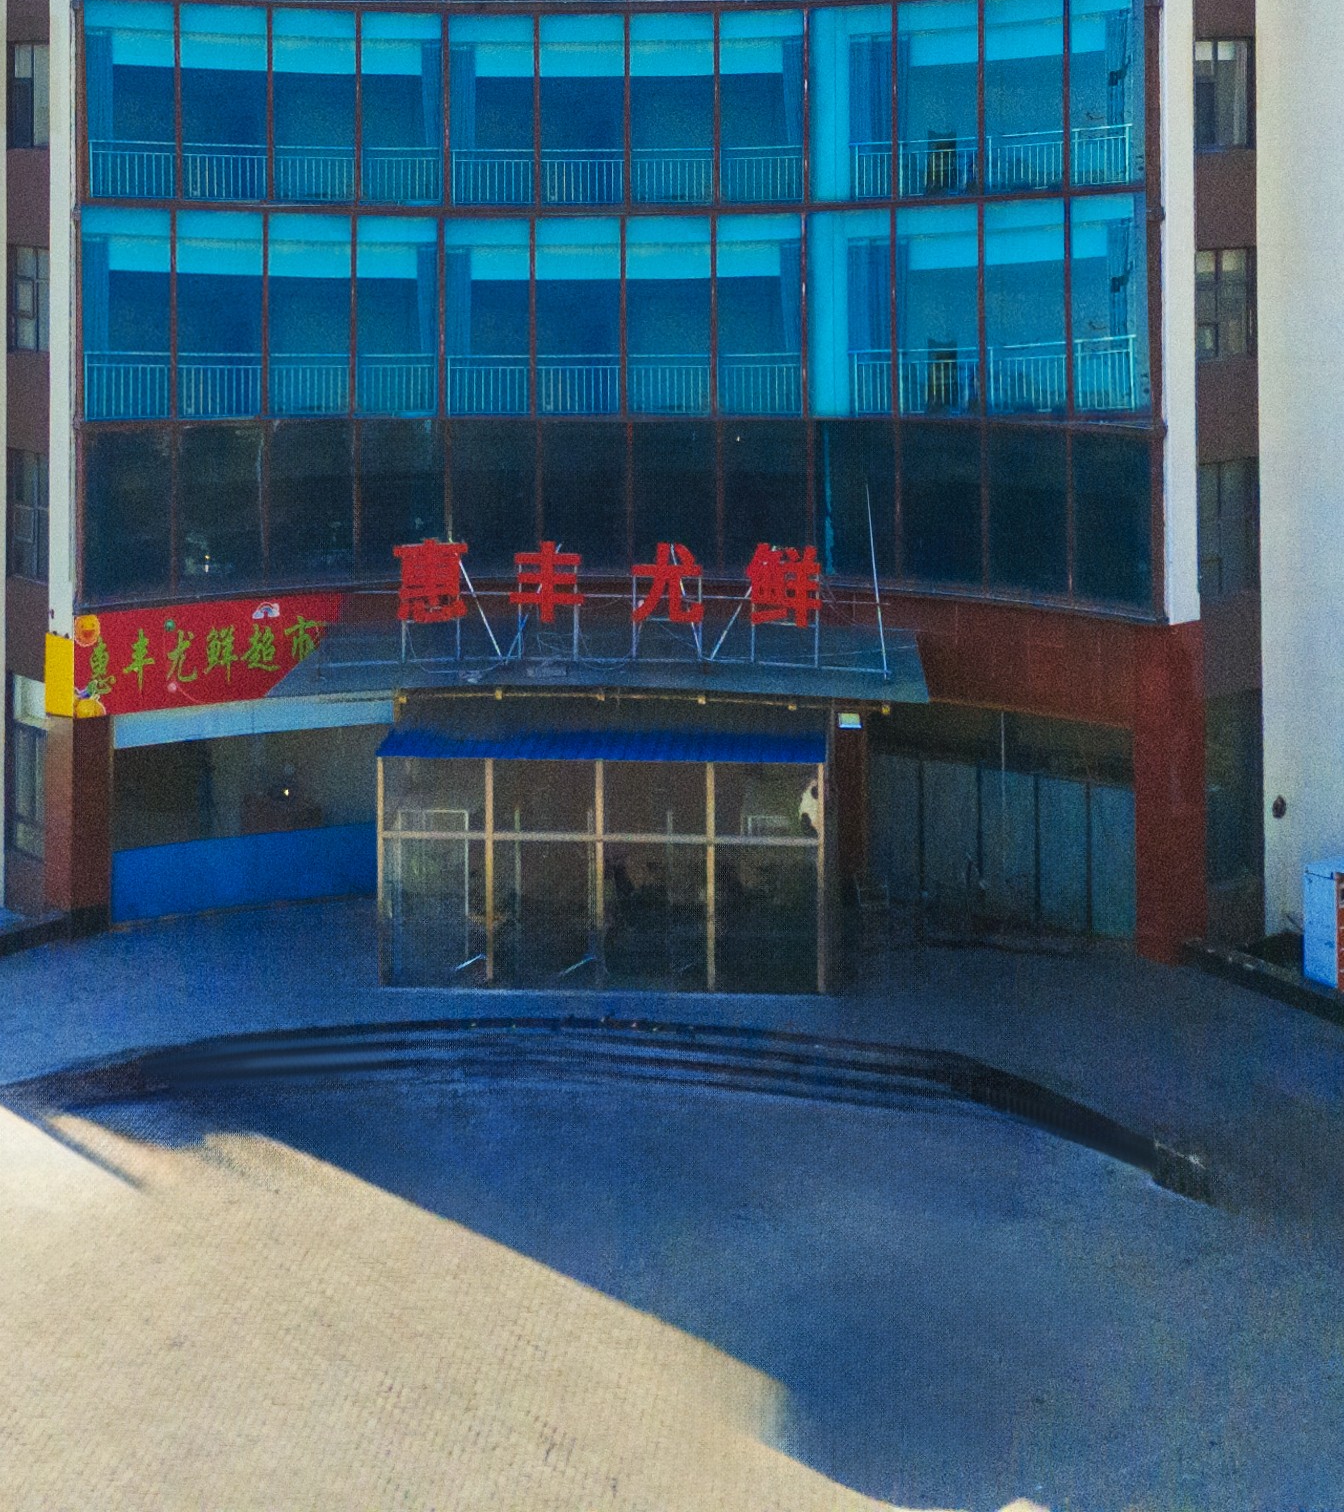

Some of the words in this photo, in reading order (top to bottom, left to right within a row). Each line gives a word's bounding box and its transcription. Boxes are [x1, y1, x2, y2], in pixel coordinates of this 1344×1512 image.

[393, 537, 822, 628] 惠丰尤鲜
[89, 615, 326, 694] 惠丰尤鲜超市
